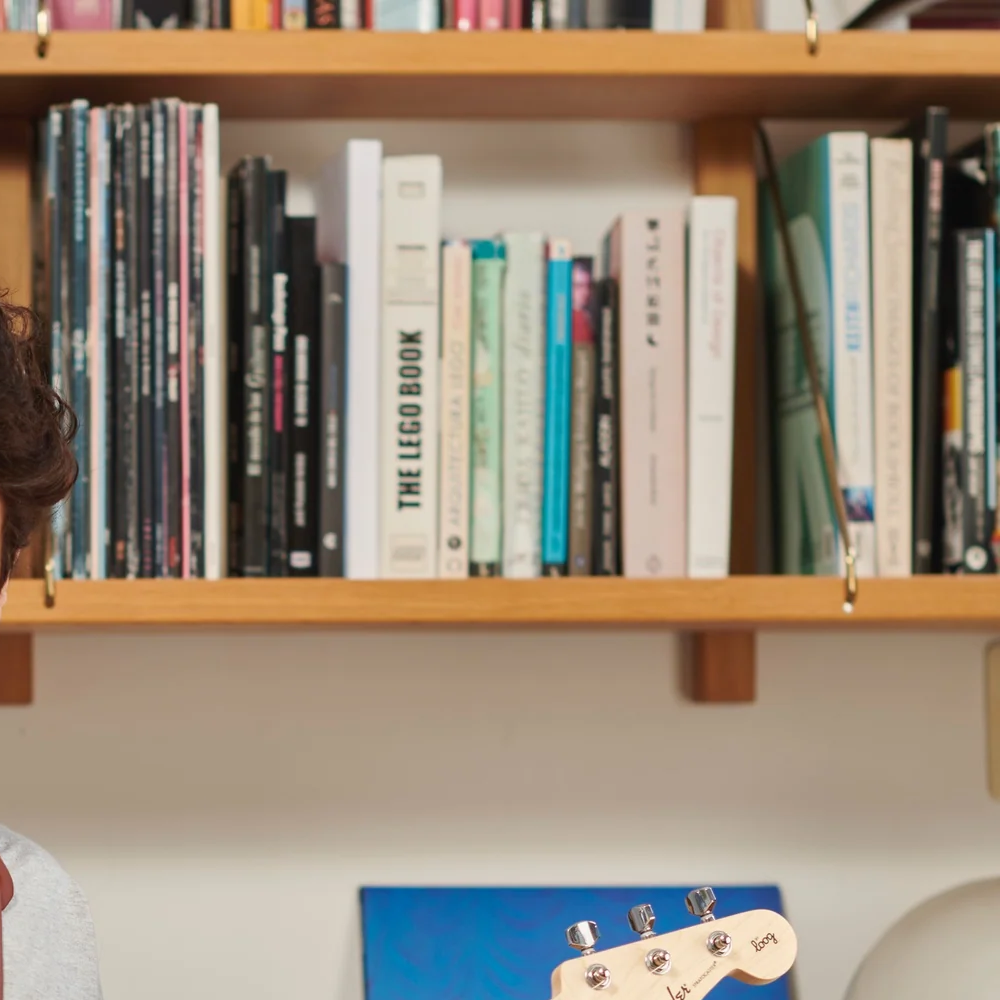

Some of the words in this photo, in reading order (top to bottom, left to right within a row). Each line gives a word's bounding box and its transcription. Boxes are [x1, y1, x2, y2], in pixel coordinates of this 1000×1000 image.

[398, 330, 422, 396] BOOK
[398, 403, 422, 460] LEGO
[398, 468, 422, 511] THE
[750, 932, 778, 952] loog
